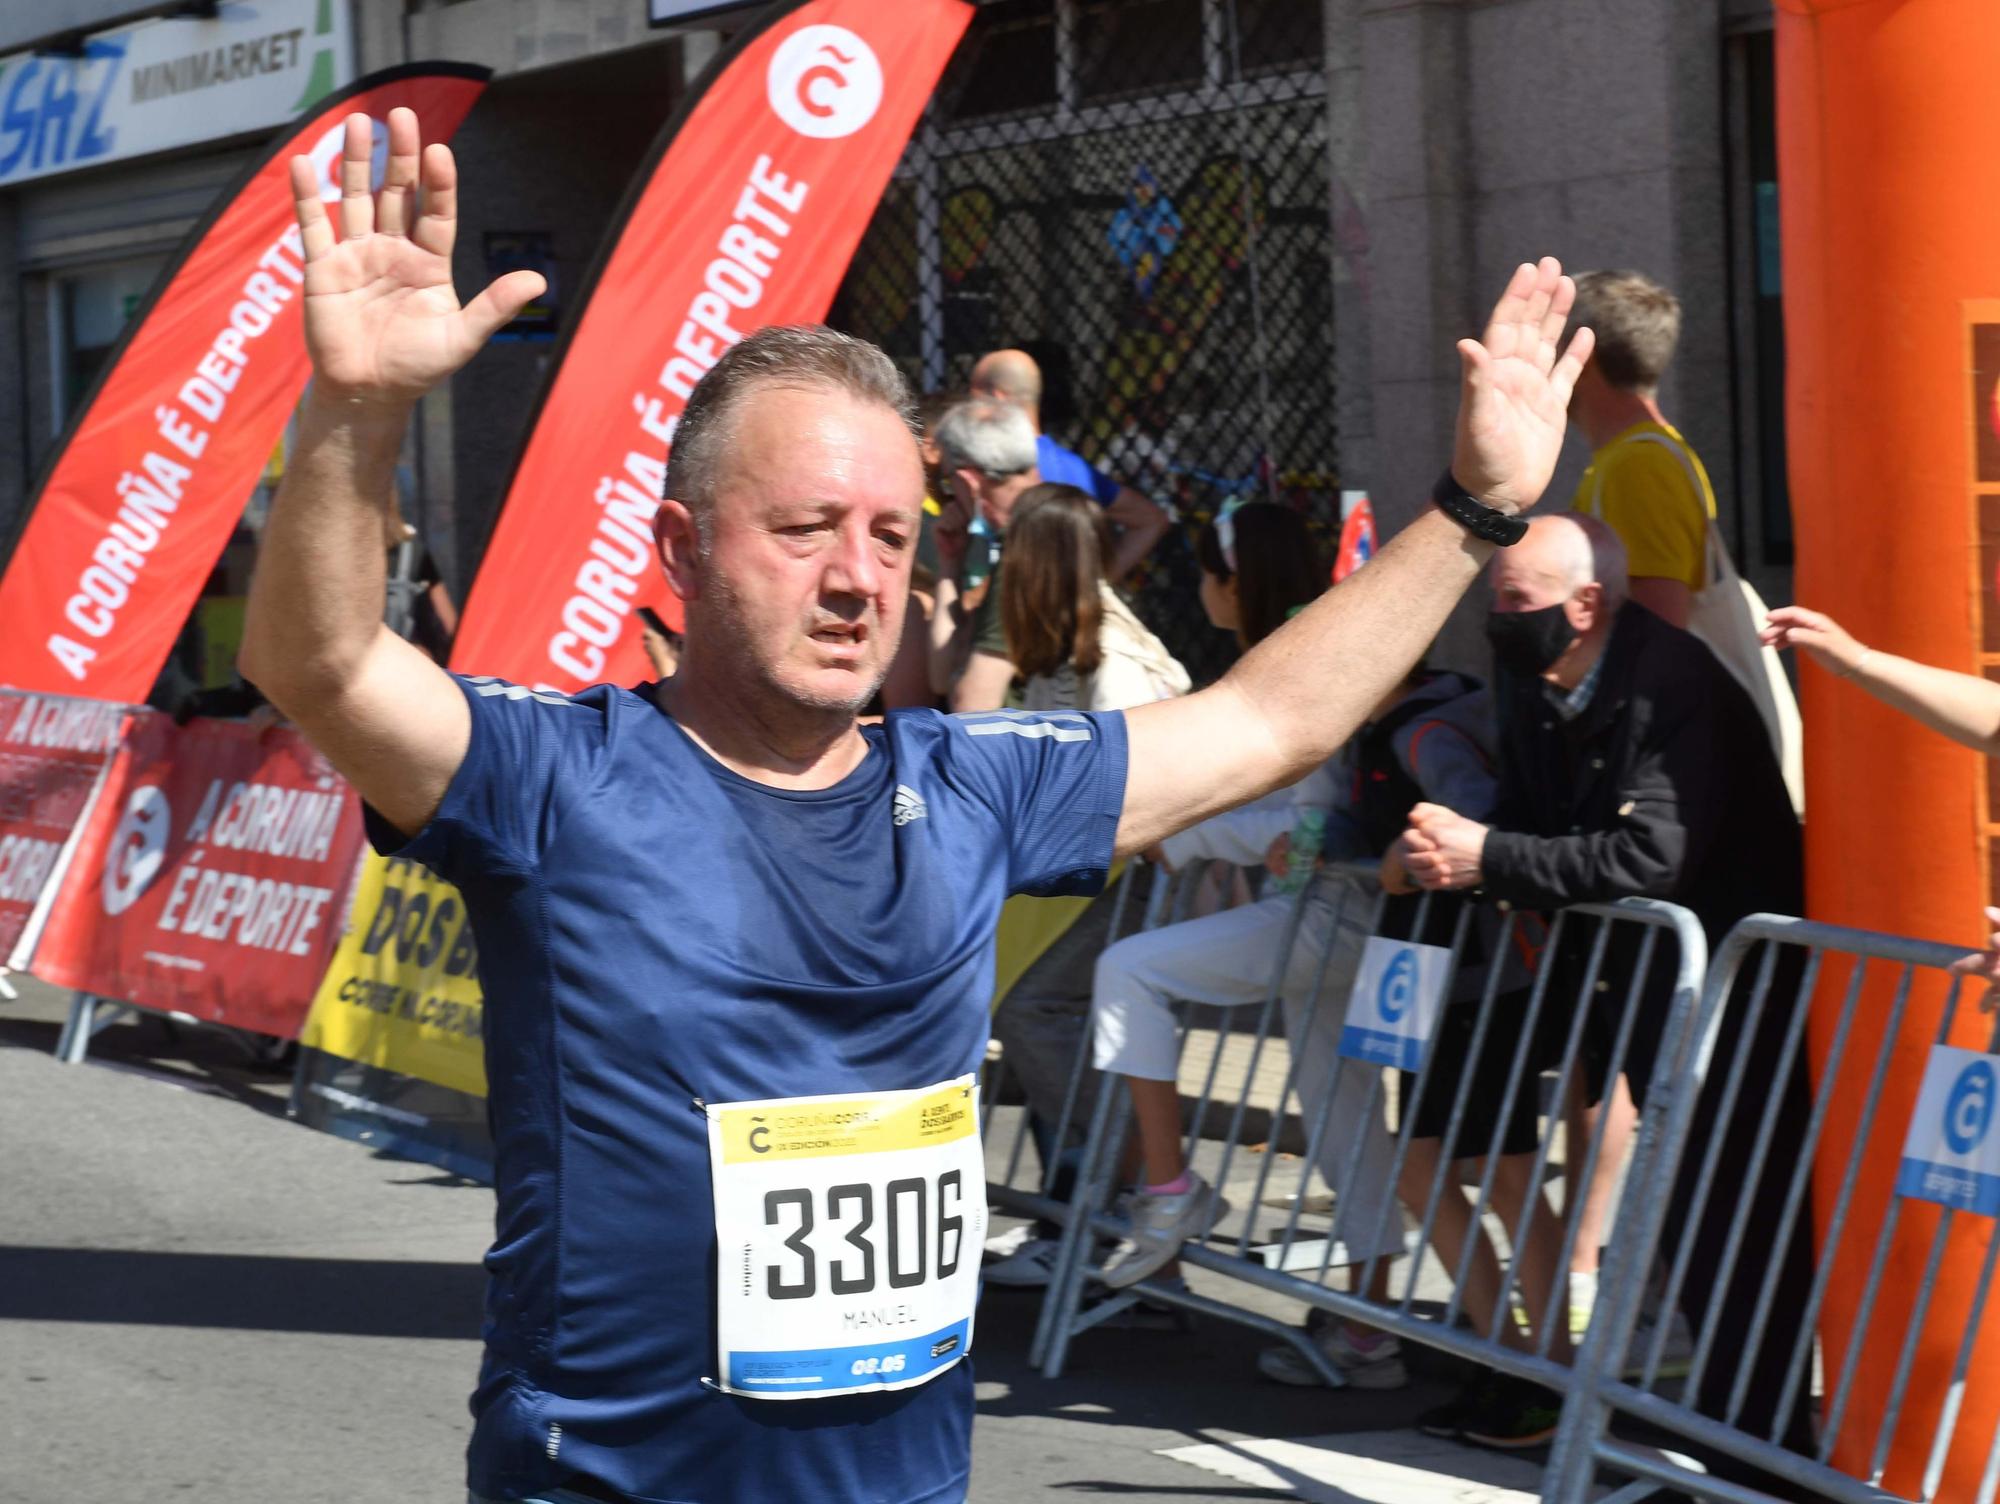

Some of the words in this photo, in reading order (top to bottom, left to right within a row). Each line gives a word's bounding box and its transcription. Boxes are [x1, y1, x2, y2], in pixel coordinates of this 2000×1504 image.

[131, 28, 305, 104] MINIMARKET
[154, 403, 209, 460] É
[549, 451, 666, 682] CORUÑA
[659, 154, 810, 386] DEPORTE
[65, 452, 192, 638] CORUÑA
[46, 634, 96, 681] A
[185, 779, 225, 843] A
[212, 776, 345, 863] CORUÑA
[157, 849, 206, 931] É
[181, 867, 334, 957] DEPORTE
[362, 885, 457, 969] DOS
[764, 1169, 963, 1300] 3306
[843, 1304, 919, 1330] MANUEL
[850, 1354, 907, 1376] 08.05
